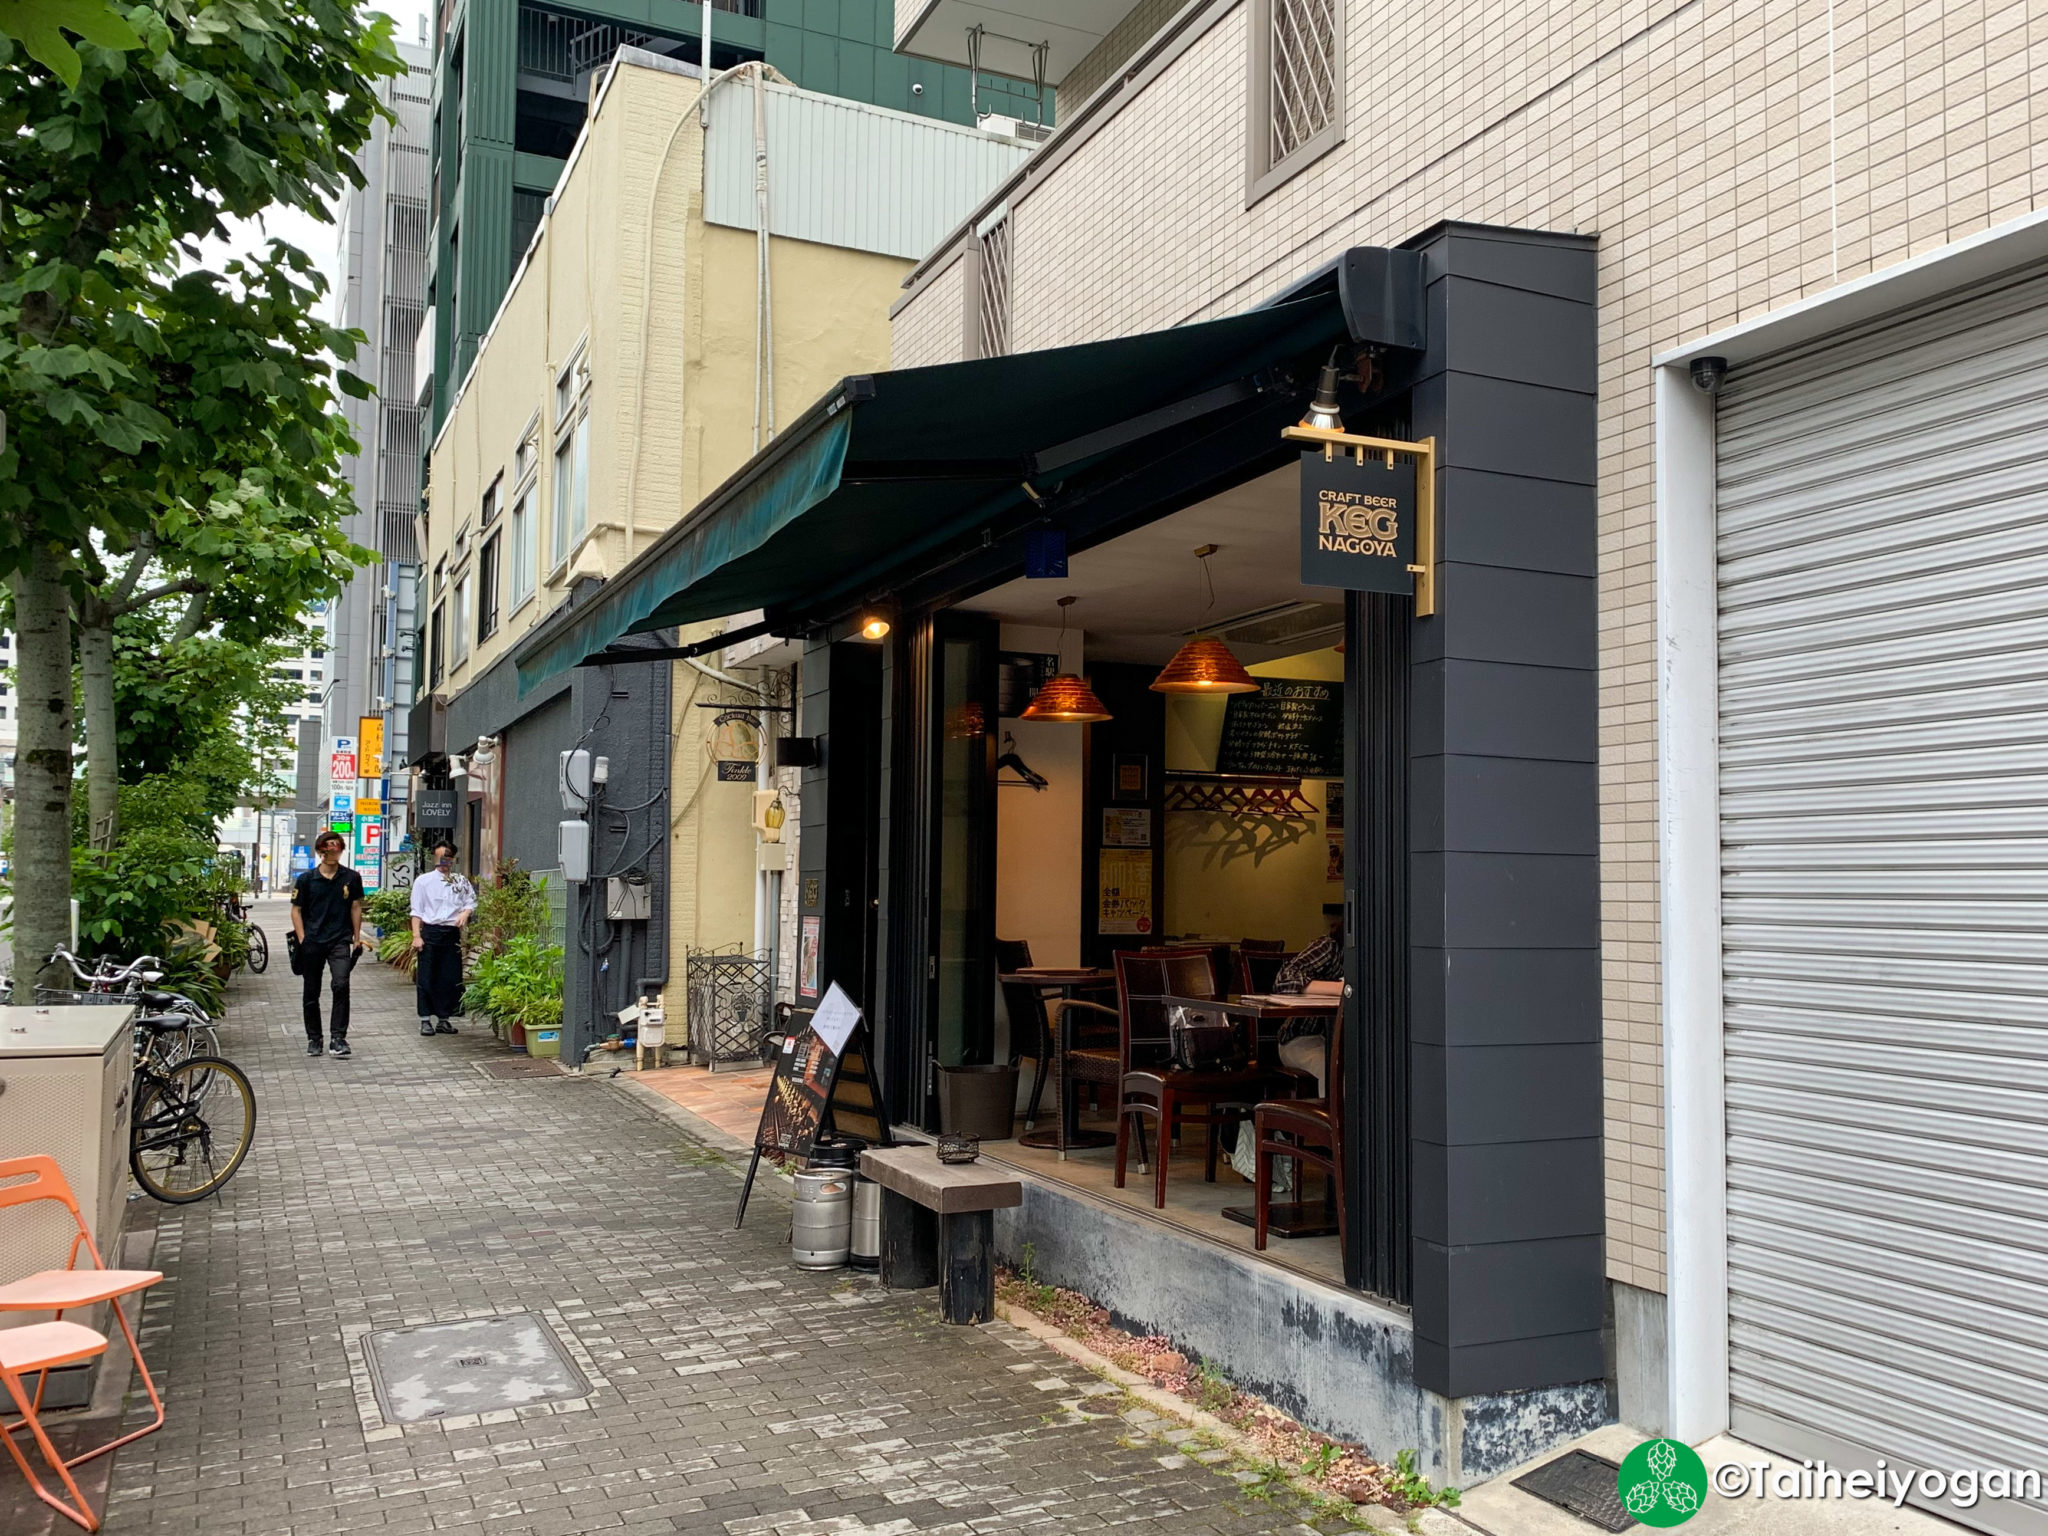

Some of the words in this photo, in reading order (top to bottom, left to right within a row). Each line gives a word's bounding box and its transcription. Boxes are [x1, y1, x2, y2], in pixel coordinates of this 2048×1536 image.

[1319, 489, 1361, 504] CRAFT
[1364, 496, 1397, 508] BEER
[1318, 502, 1398, 541] KEG
[1318, 535, 1397, 558] NAGOYA
[337, 739, 351, 748] P
[727, 773, 748, 781] 2009
[422, 801, 439, 809] Jazz
[422, 809, 451, 817] LOVELY
[366, 825, 381, 845] P
